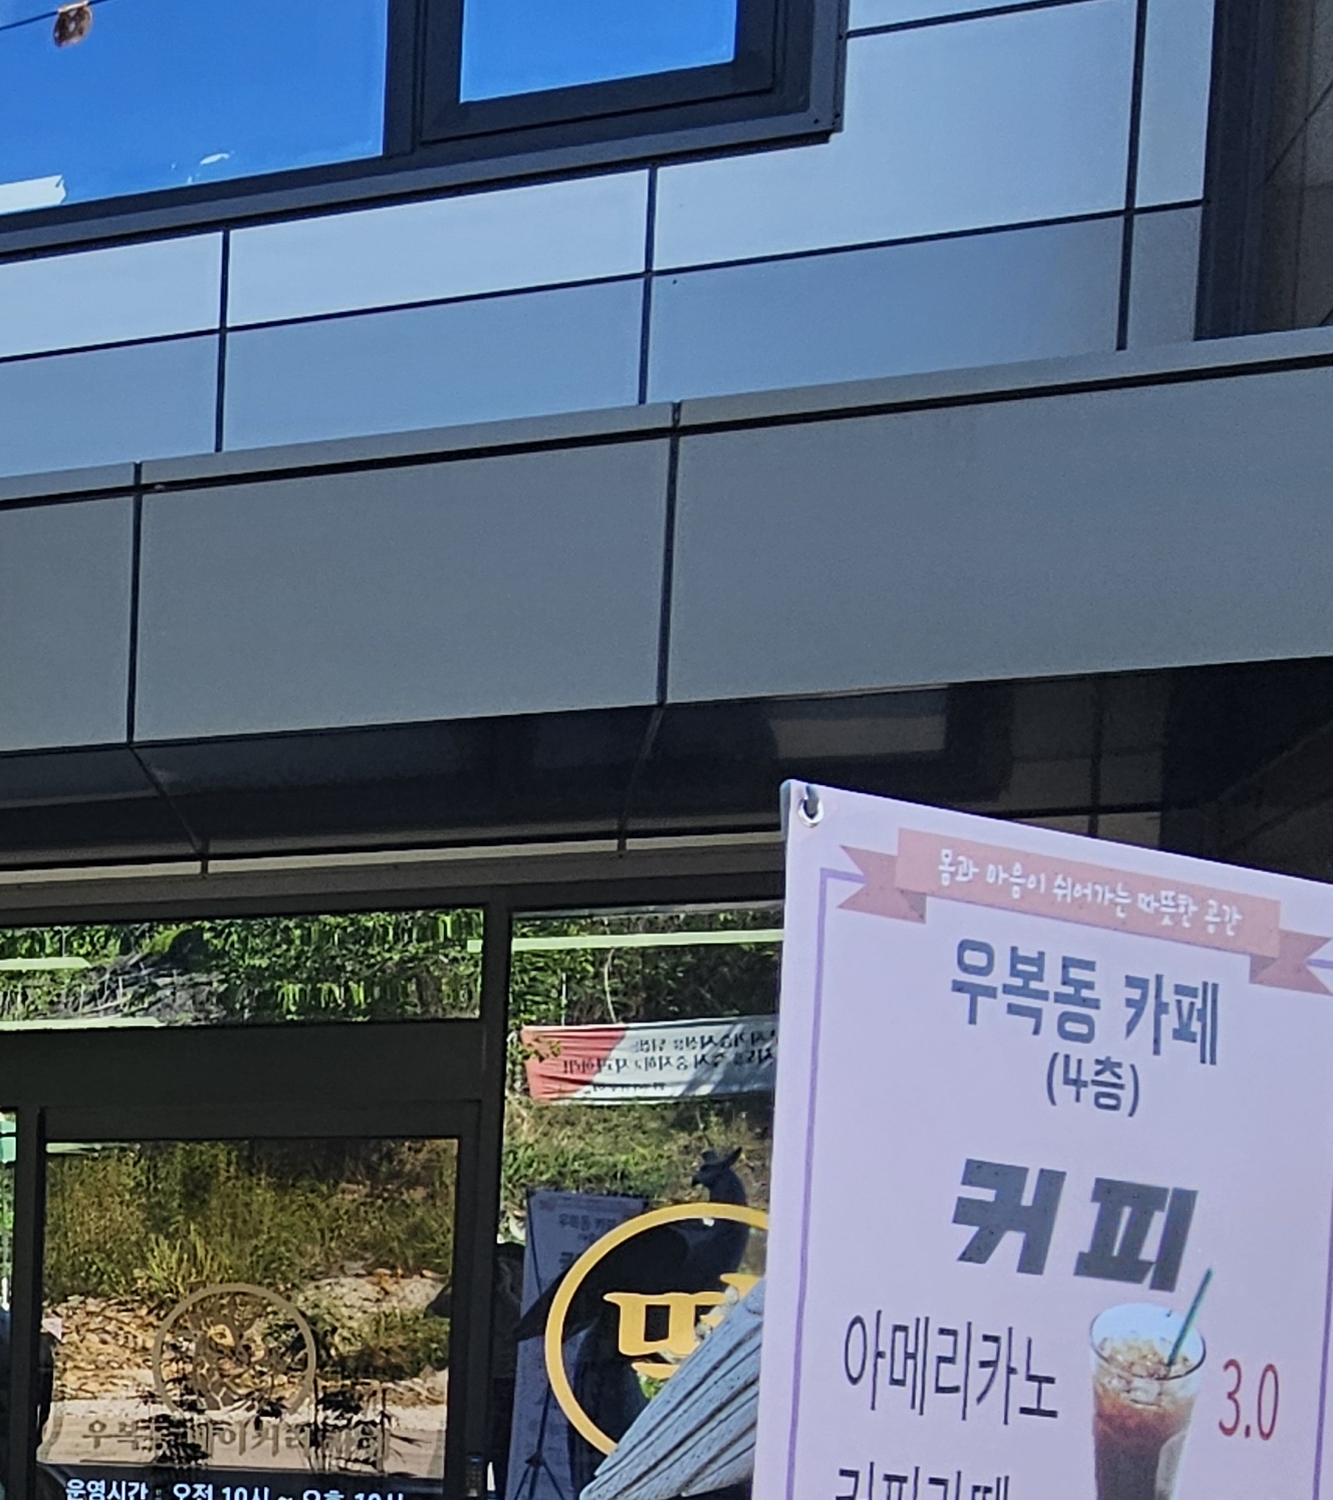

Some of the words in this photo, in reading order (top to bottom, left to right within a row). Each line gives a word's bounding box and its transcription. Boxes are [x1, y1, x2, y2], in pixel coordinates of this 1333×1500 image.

[938, 849, 980, 886] 몸과
[985, 862, 1046, 899] 마음이
[1053, 874, 1132, 918] 쉬어가는
[1137, 890, 1199, 928] 따뜻한
[1204, 899, 1243, 936] 공간
[951, 938, 1101, 1045] 우복동
[1124, 974, 1220, 1065] 카페
[1046, 1052, 1141, 1118] (4층)
[951, 1158, 1199, 1293] 커피
[843, 1309, 1058, 1426] 아메리카노
[1218, 1358, 1280, 1440] 3.0
